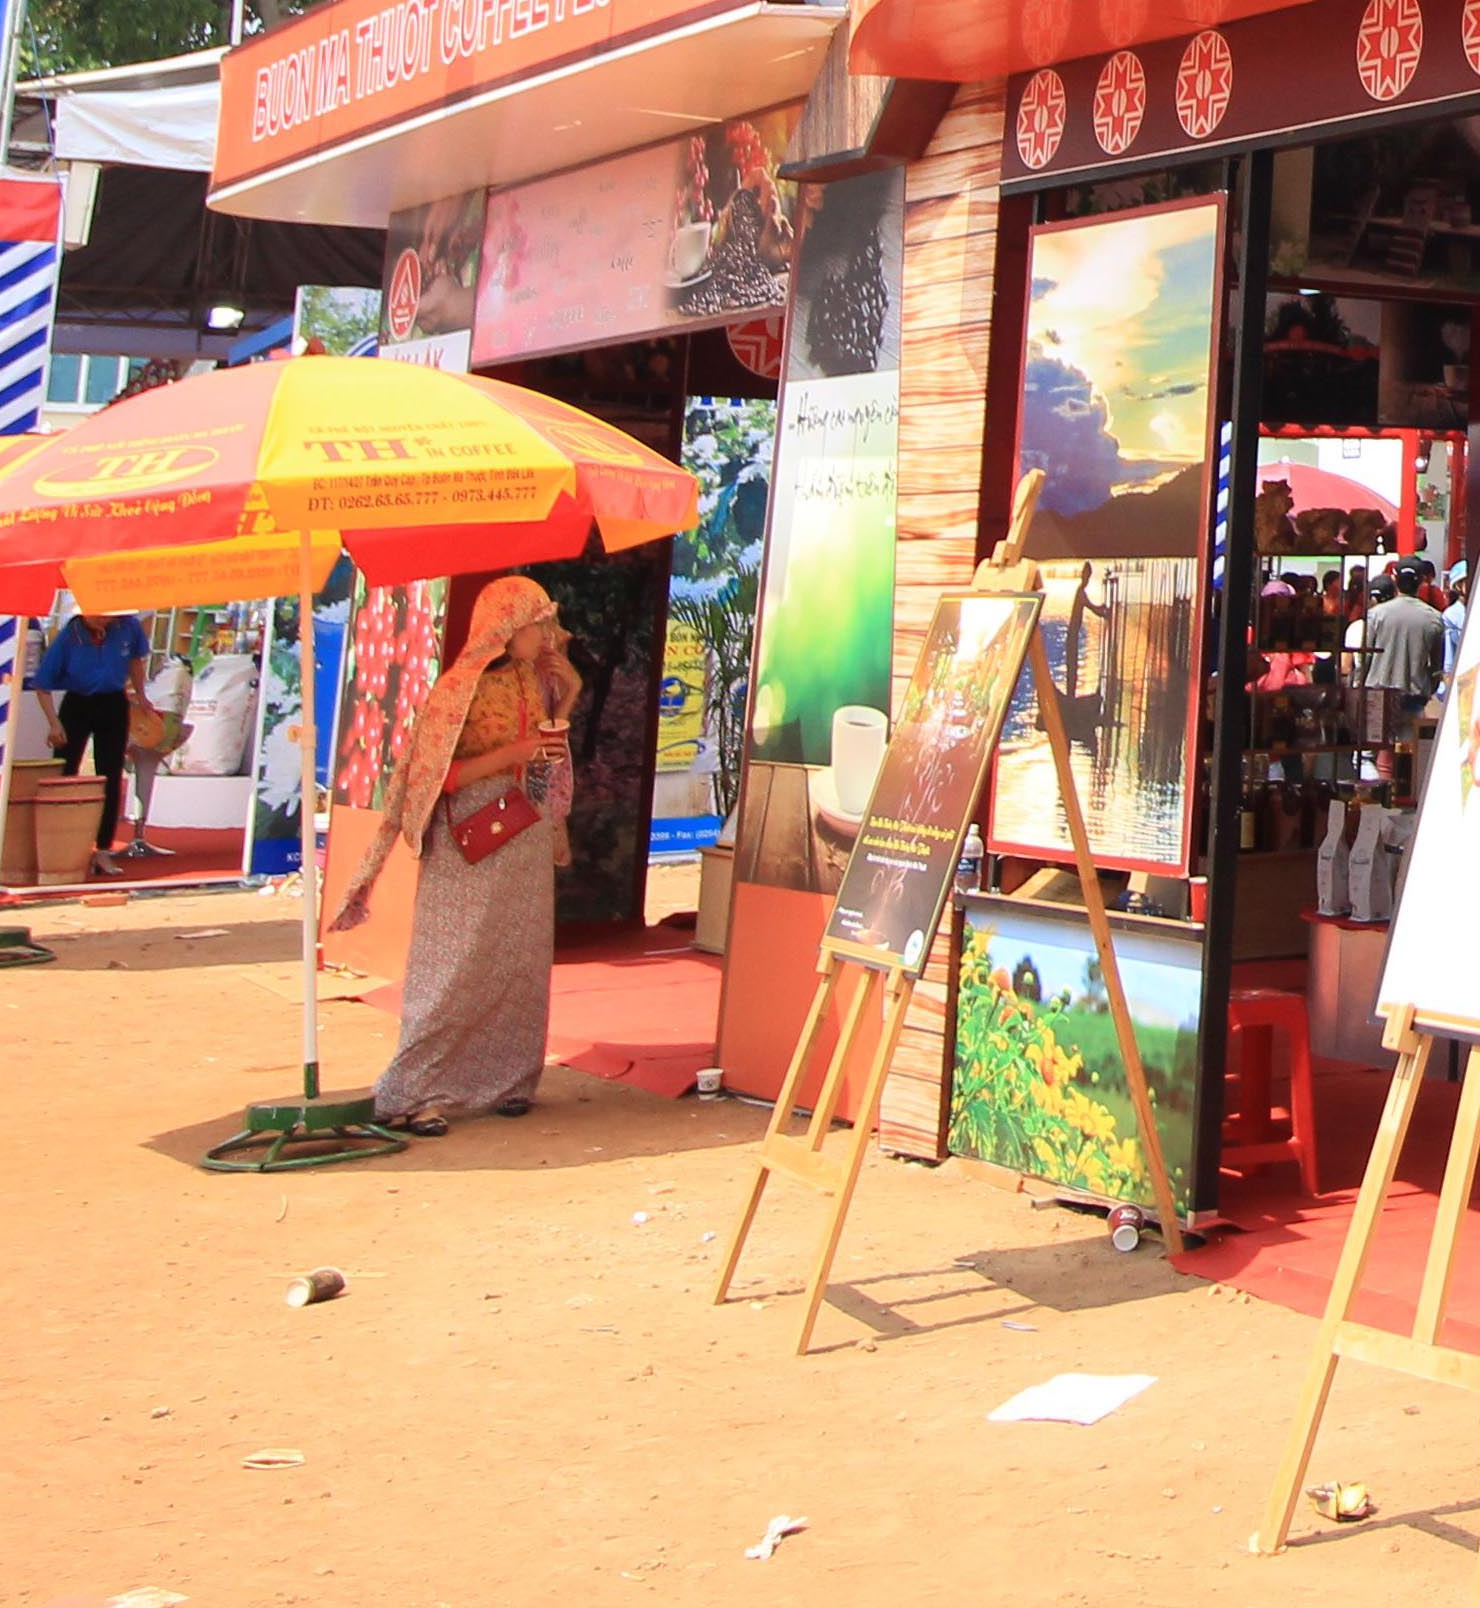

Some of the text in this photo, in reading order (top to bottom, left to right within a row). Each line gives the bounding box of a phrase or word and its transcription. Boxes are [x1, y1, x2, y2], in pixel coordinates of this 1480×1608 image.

[252, 43, 316, 143] BUON
[315, 29, 350, 118] MA
[303, 437, 418, 463] TH
[448, 442, 518, 457] COFFEE
[88, 448, 187, 481] TH
